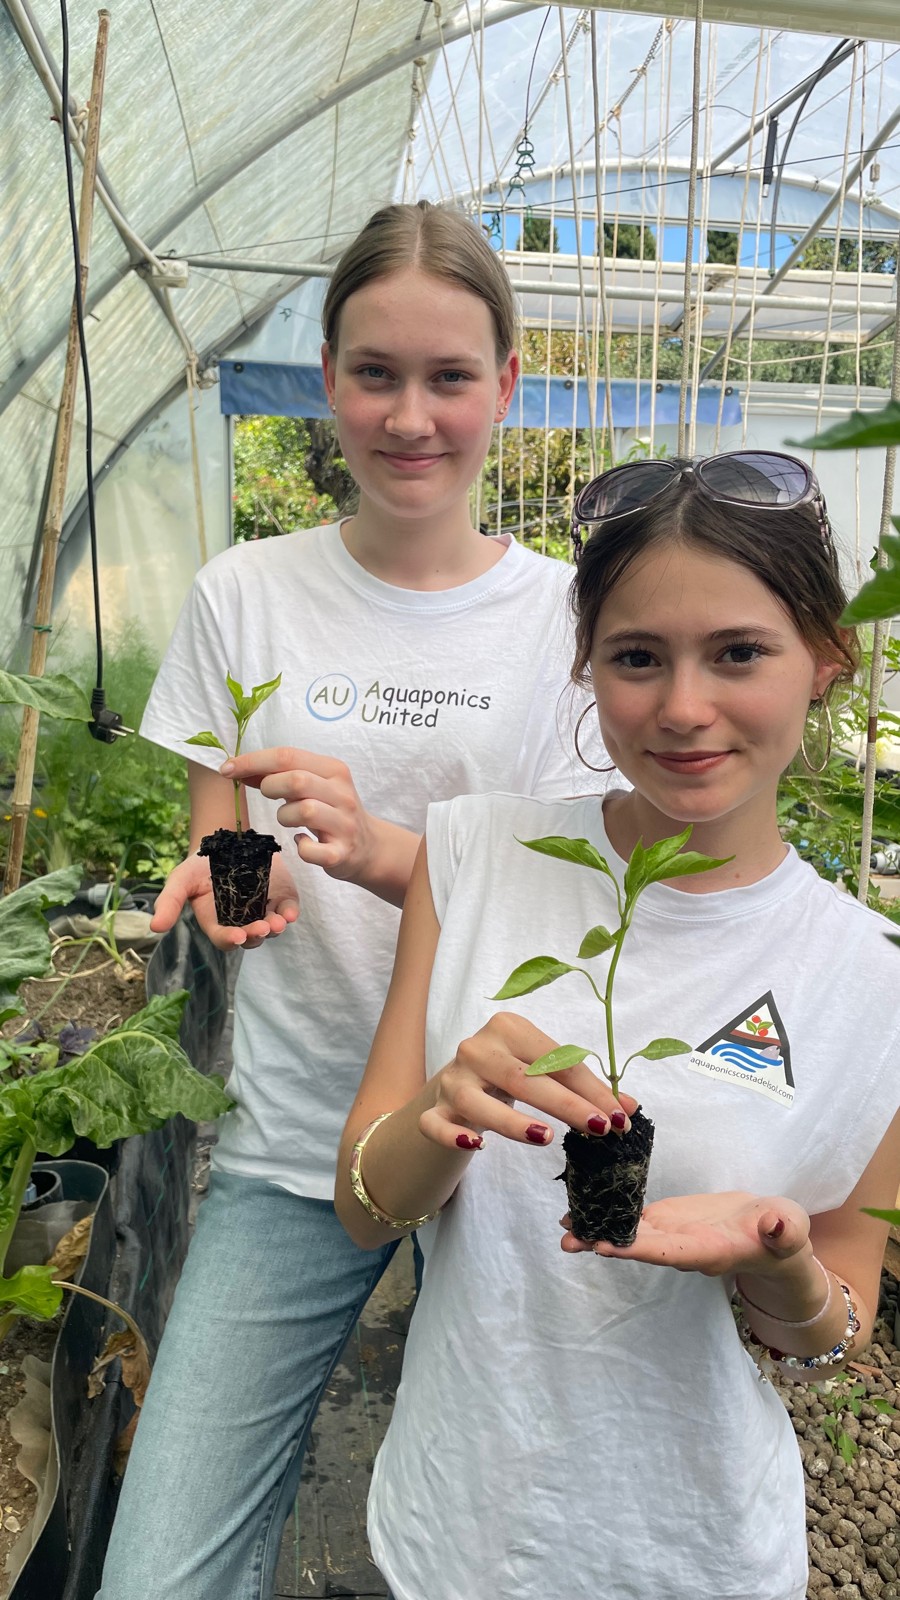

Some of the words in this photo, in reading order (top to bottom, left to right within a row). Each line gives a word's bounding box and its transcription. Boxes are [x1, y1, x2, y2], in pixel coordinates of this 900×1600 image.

[313, 686, 350, 707] AU
[364, 680, 491, 710] Aquaponics
[361, 703, 439, 728] United
[690, 1056, 794, 1101] aquaponicscostadelsol.com
